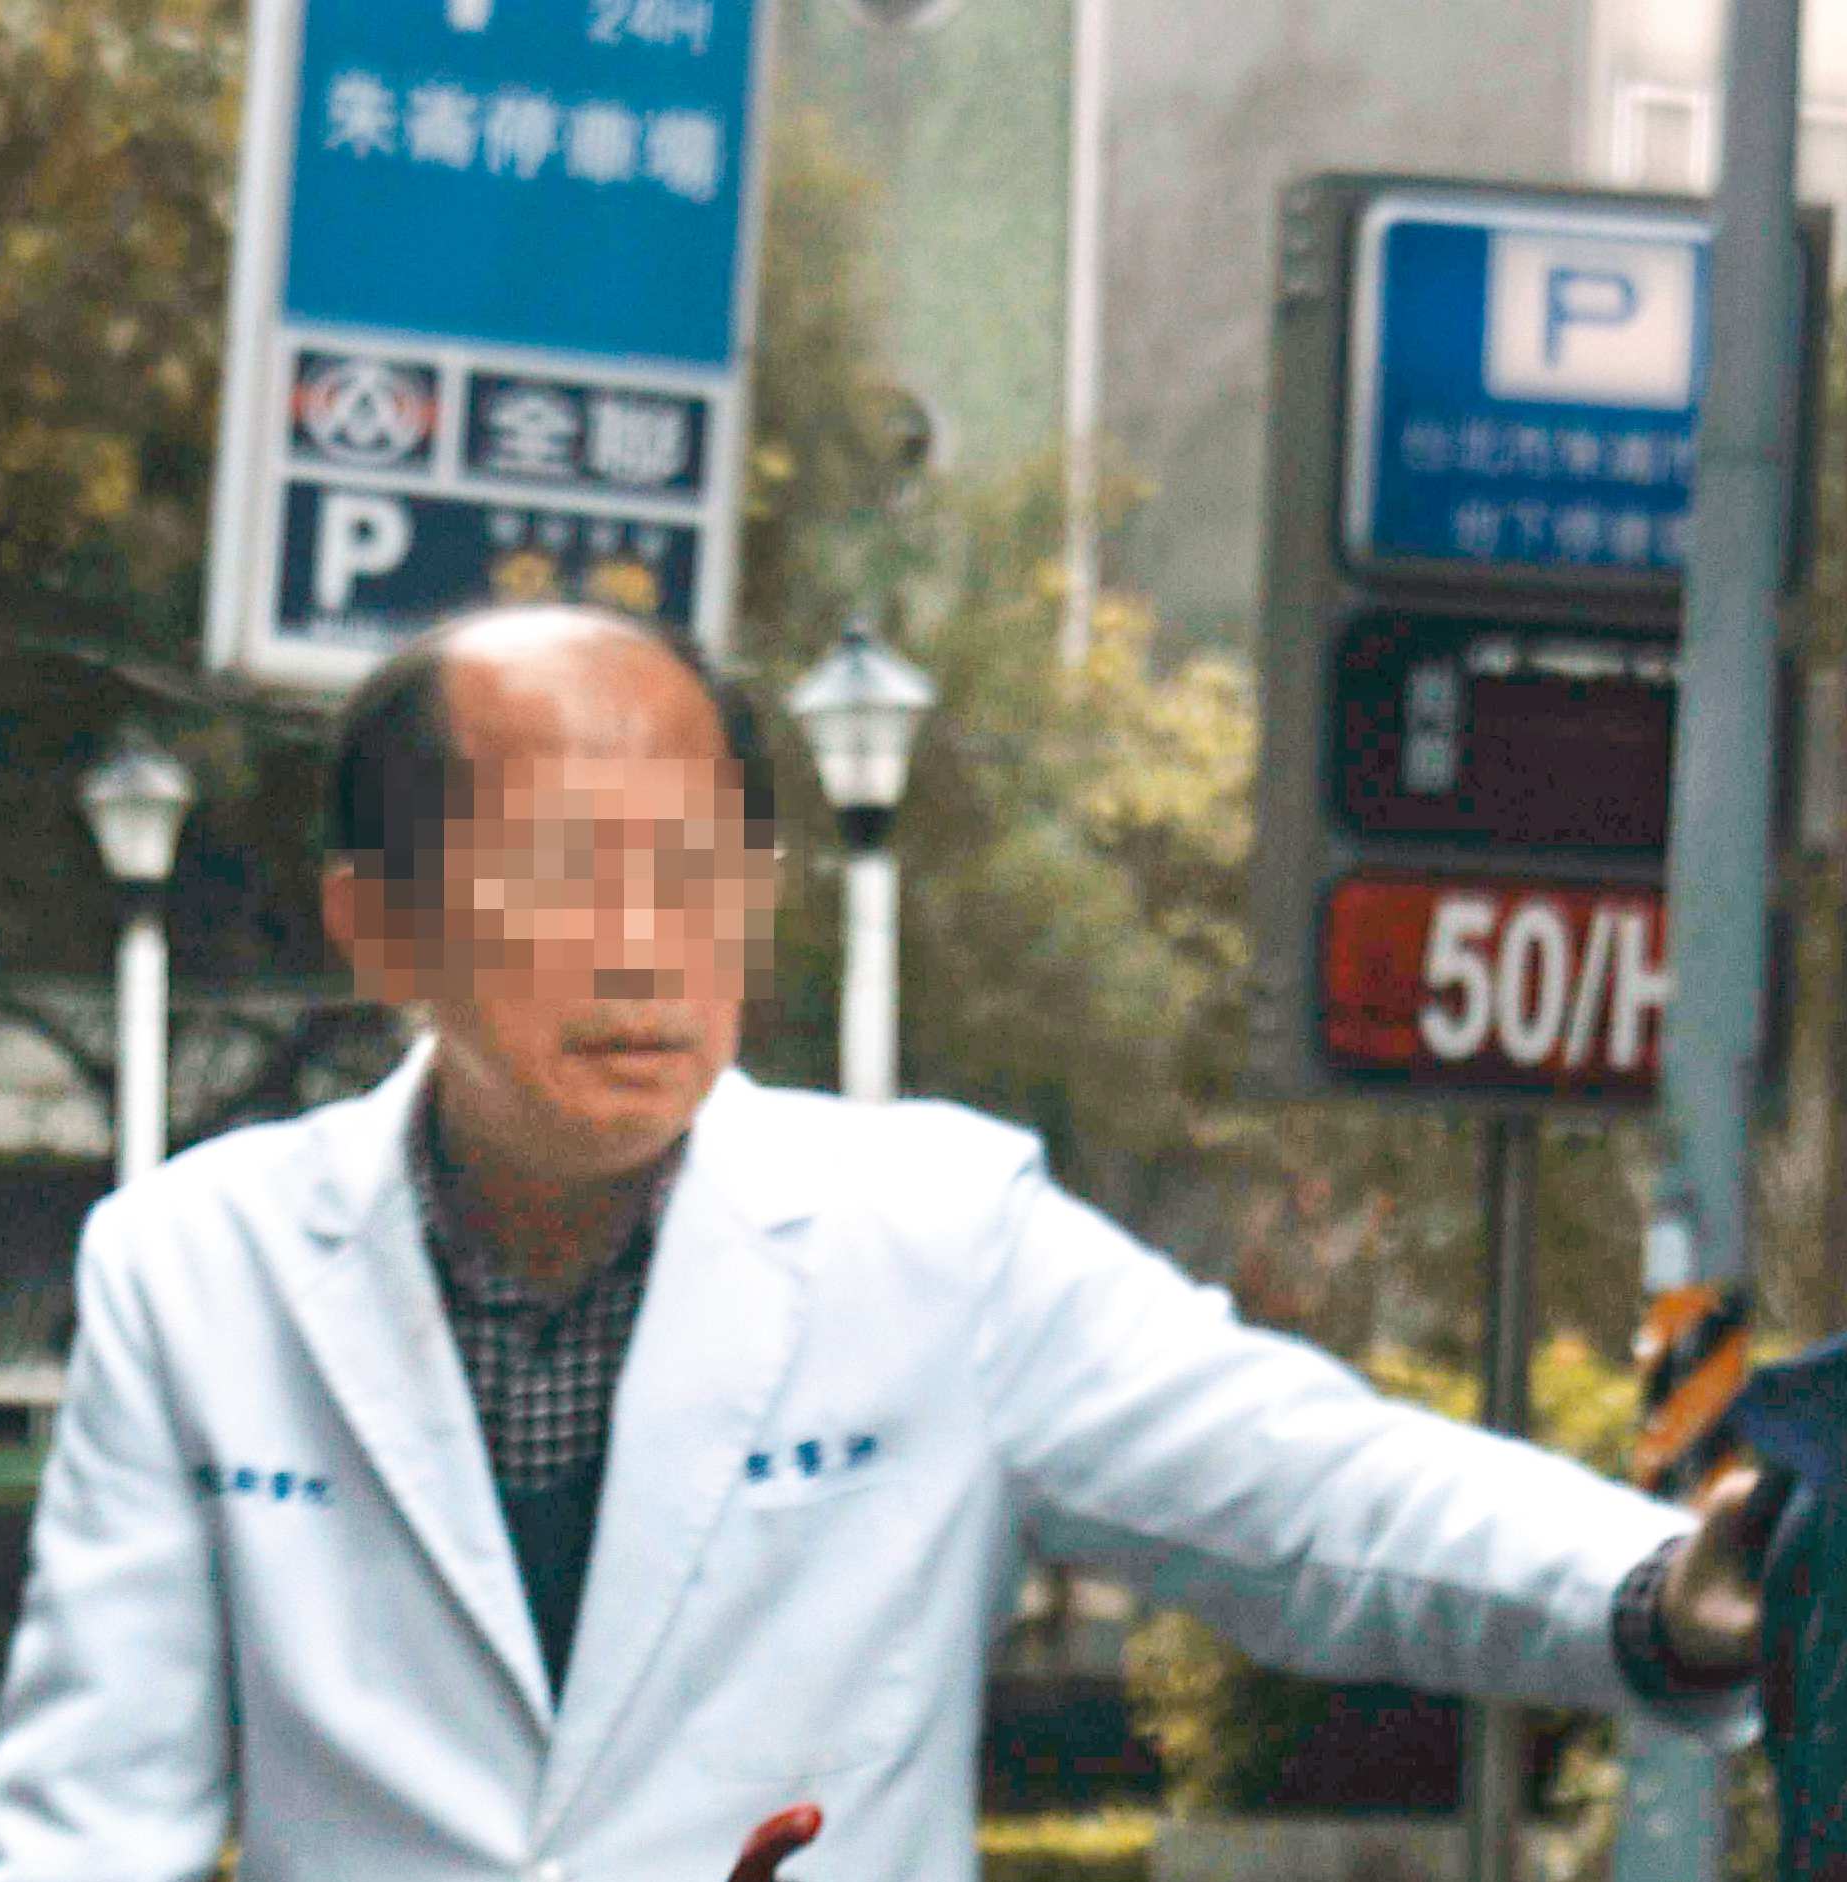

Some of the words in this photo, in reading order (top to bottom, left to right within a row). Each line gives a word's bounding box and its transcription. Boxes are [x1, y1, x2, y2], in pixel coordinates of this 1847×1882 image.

[1541, 266, 1639, 368] P
[316, 492, 414, 609] P
[1417, 895, 1677, 1068] 50/H
